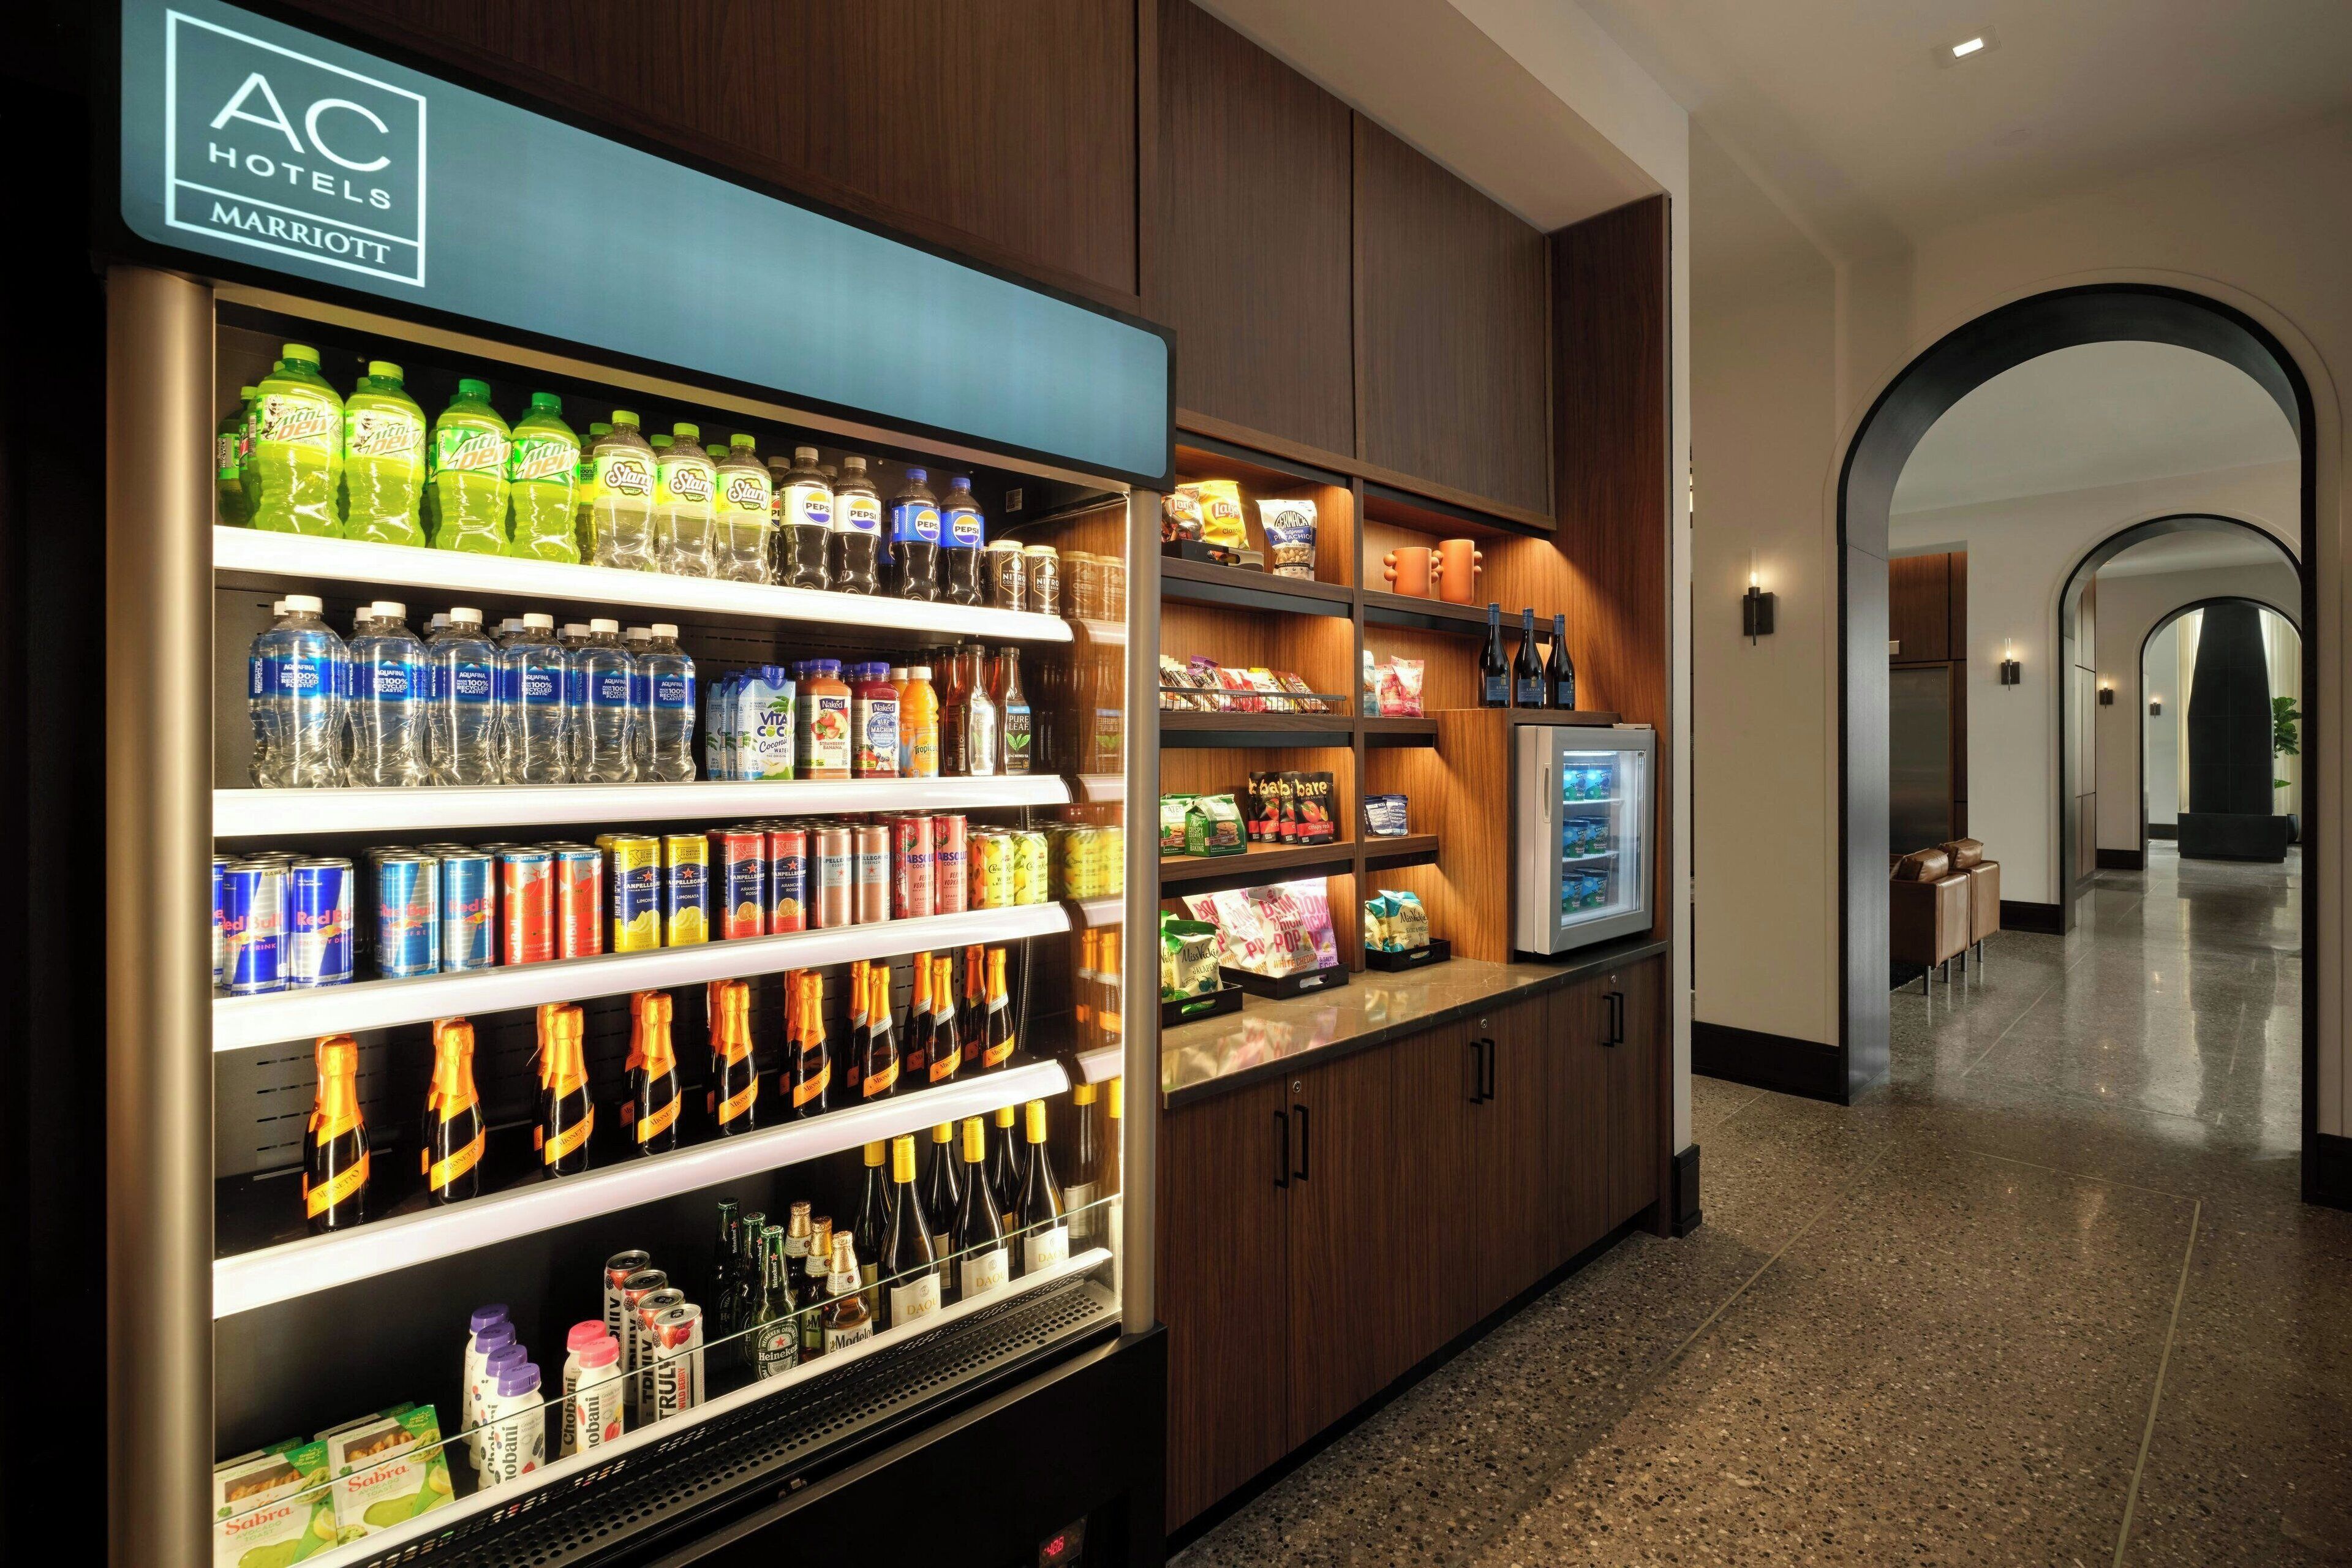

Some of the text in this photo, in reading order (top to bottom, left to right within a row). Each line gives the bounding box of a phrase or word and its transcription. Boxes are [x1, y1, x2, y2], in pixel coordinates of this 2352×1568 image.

[209, 72, 391, 172] AC
[209, 142, 391, 209] HOTELS
[209, 202, 390, 264] MARRIOTT
[605, 461, 654, 497] Starry
[669, 468, 714, 502] Starry
[727, 478, 771, 511] Starry
[806, 503, 831, 514] PEPS
[850, 510, 876, 521] PEPSI
[955, 525, 979, 535] PEPSI
[1274, 533, 1313, 541] PITACHIOS
[1036, 577, 1059, 586] NITRO
[874, 704, 894, 712] Naked
[760, 710, 788, 725] VITA
[760, 737, 787, 753] Coconu
[1260, 778, 1280, 796] ba
[1295, 778, 1327, 797] bare
[907, 854, 935, 864] ABSOLU
[297, 910, 330, 926] Red
[406, 901, 435, 917] Bull
[1273, 929, 1302, 954] POP
[1273, 953, 1317, 969] WHITE CHEDDA
[1038, 1248, 1068, 1263] DAOU
[976, 1270, 1008, 1287] DAOU
[907, 1295, 938, 1316] DAOU
[761, 1327, 797, 1348] HEINEKEN ORIGINAL
[758, 1344, 798, 1362] Heineken
[348, 1463, 407, 1493] Sabra
[358, 1477, 400, 1496] AVOCADO
[368, 1485, 394, 1498] TOAST
[225, 1504, 292, 1536] Sabra
[235, 1520, 282, 1541] AVOCADO
